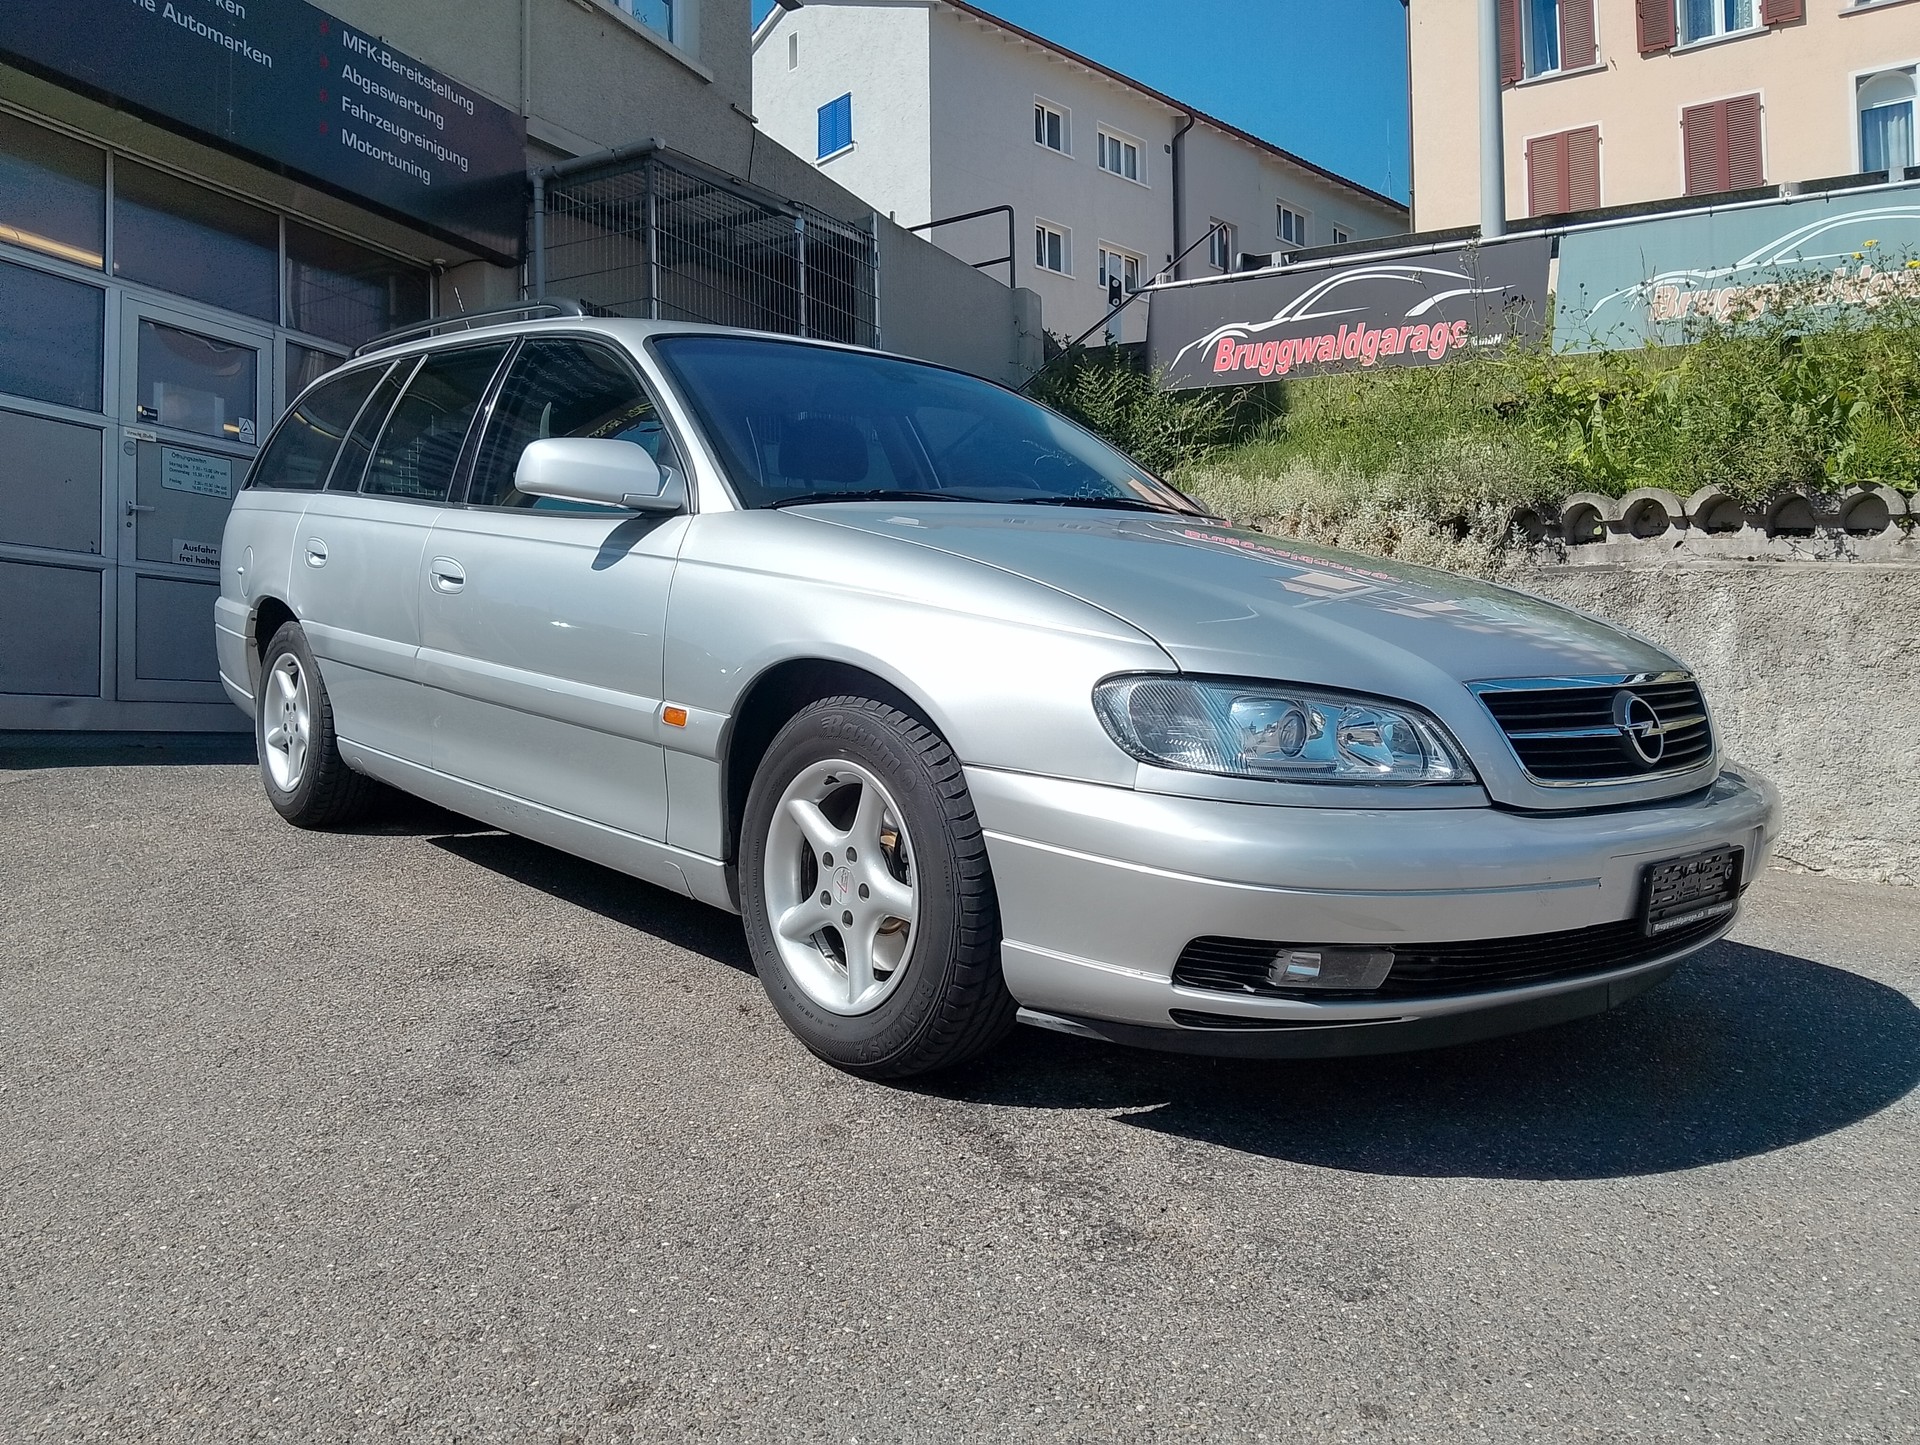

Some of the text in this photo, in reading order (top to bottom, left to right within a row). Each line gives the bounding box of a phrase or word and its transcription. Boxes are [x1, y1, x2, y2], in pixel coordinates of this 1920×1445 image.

[162, 2, 273, 68] Automarken
[341, 64, 444, 131] Abgaswartung
[342, 30, 474, 116] MFK-Bereitstellung
[341, 96, 469, 173] Fahrzeugreinigung
[341, 128, 432, 186] Motortuning
[1213, 320, 1468, 377] Bruggwaldgarage
[179, 553, 220, 566] frei halten
